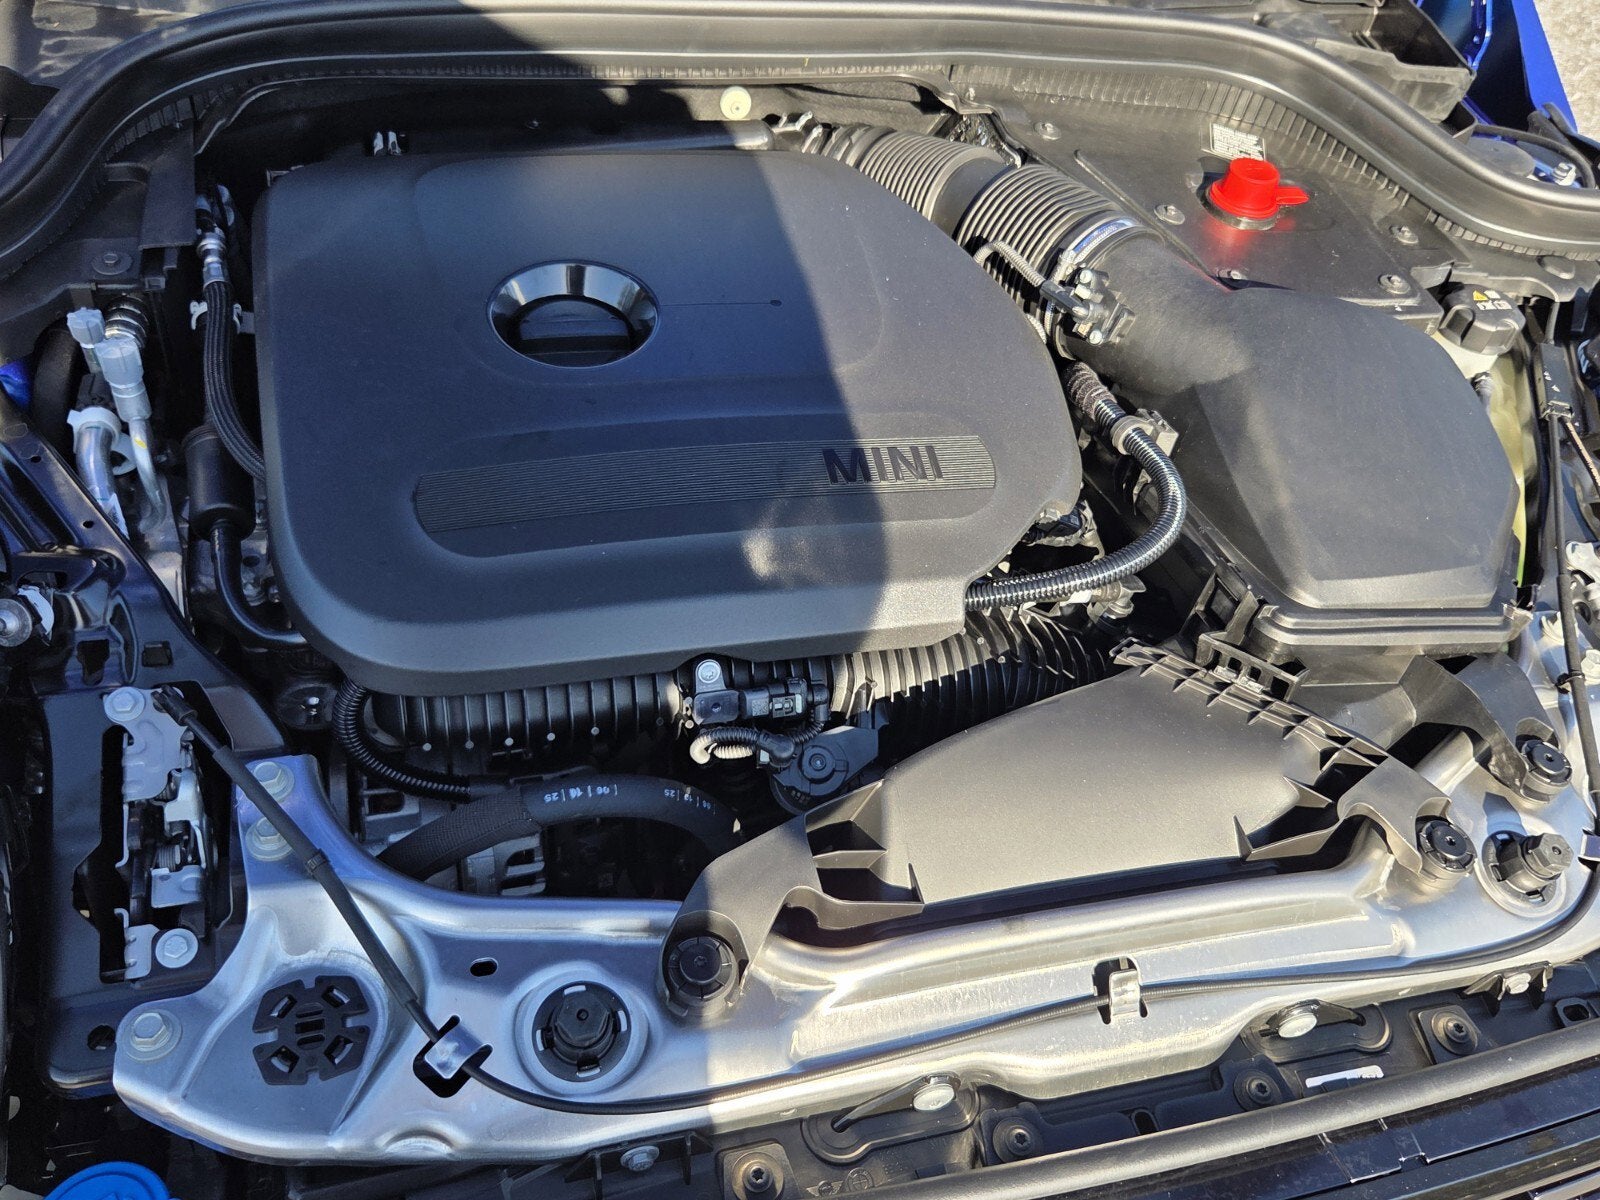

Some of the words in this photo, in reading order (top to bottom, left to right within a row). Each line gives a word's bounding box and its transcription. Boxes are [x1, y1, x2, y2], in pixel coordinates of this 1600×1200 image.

[822, 446, 944, 485] MINI
[543, 792, 559, 803] 25
[664, 788, 676, 798] 25
